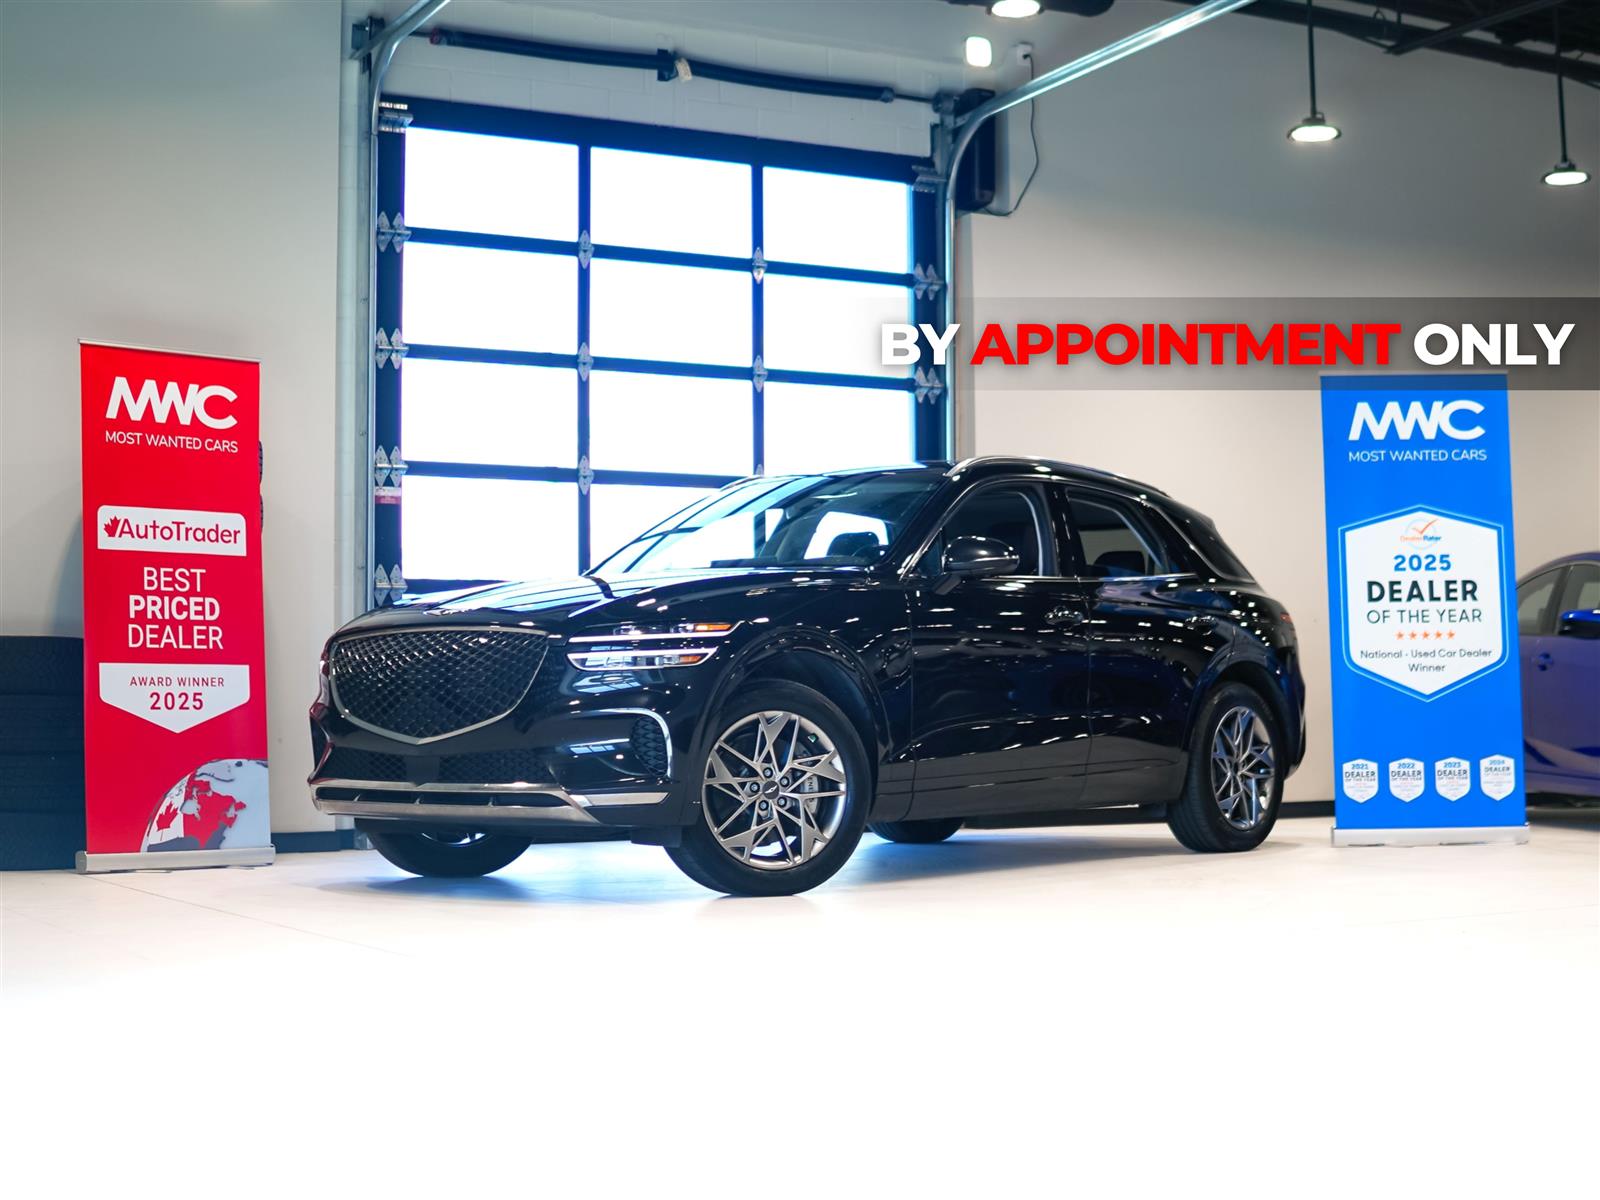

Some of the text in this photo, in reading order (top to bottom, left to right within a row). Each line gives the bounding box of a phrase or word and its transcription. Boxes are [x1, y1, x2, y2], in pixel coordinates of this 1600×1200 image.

[105, 376, 238, 430] MWC
[1348, 399, 1486, 441] MWC
[105, 431, 239, 453] MOST WANTED CARS
[1348, 449, 1488, 462] MOST WANTED CARS
[117, 518, 241, 544] AutoTrader
[1393, 554, 1452, 572] 2025
[143, 566, 206, 592] BEST
[1366, 579, 1478, 603] DEALER
[129, 595, 220, 621] PRICED
[1366, 608, 1482, 624] OF THE YEAR
[128, 623, 224, 650] DEALER
[1360, 650, 1403, 659] National
[1410, 649, 1436, 658] Used
[1438, 649, 1457, 658] Car
[1458, 648, 1492, 657] Dealer
[1408, 663, 1446, 672] Winner
[129, 676, 224, 687] AWARD WINNER
[149, 692, 204, 711] 2025
